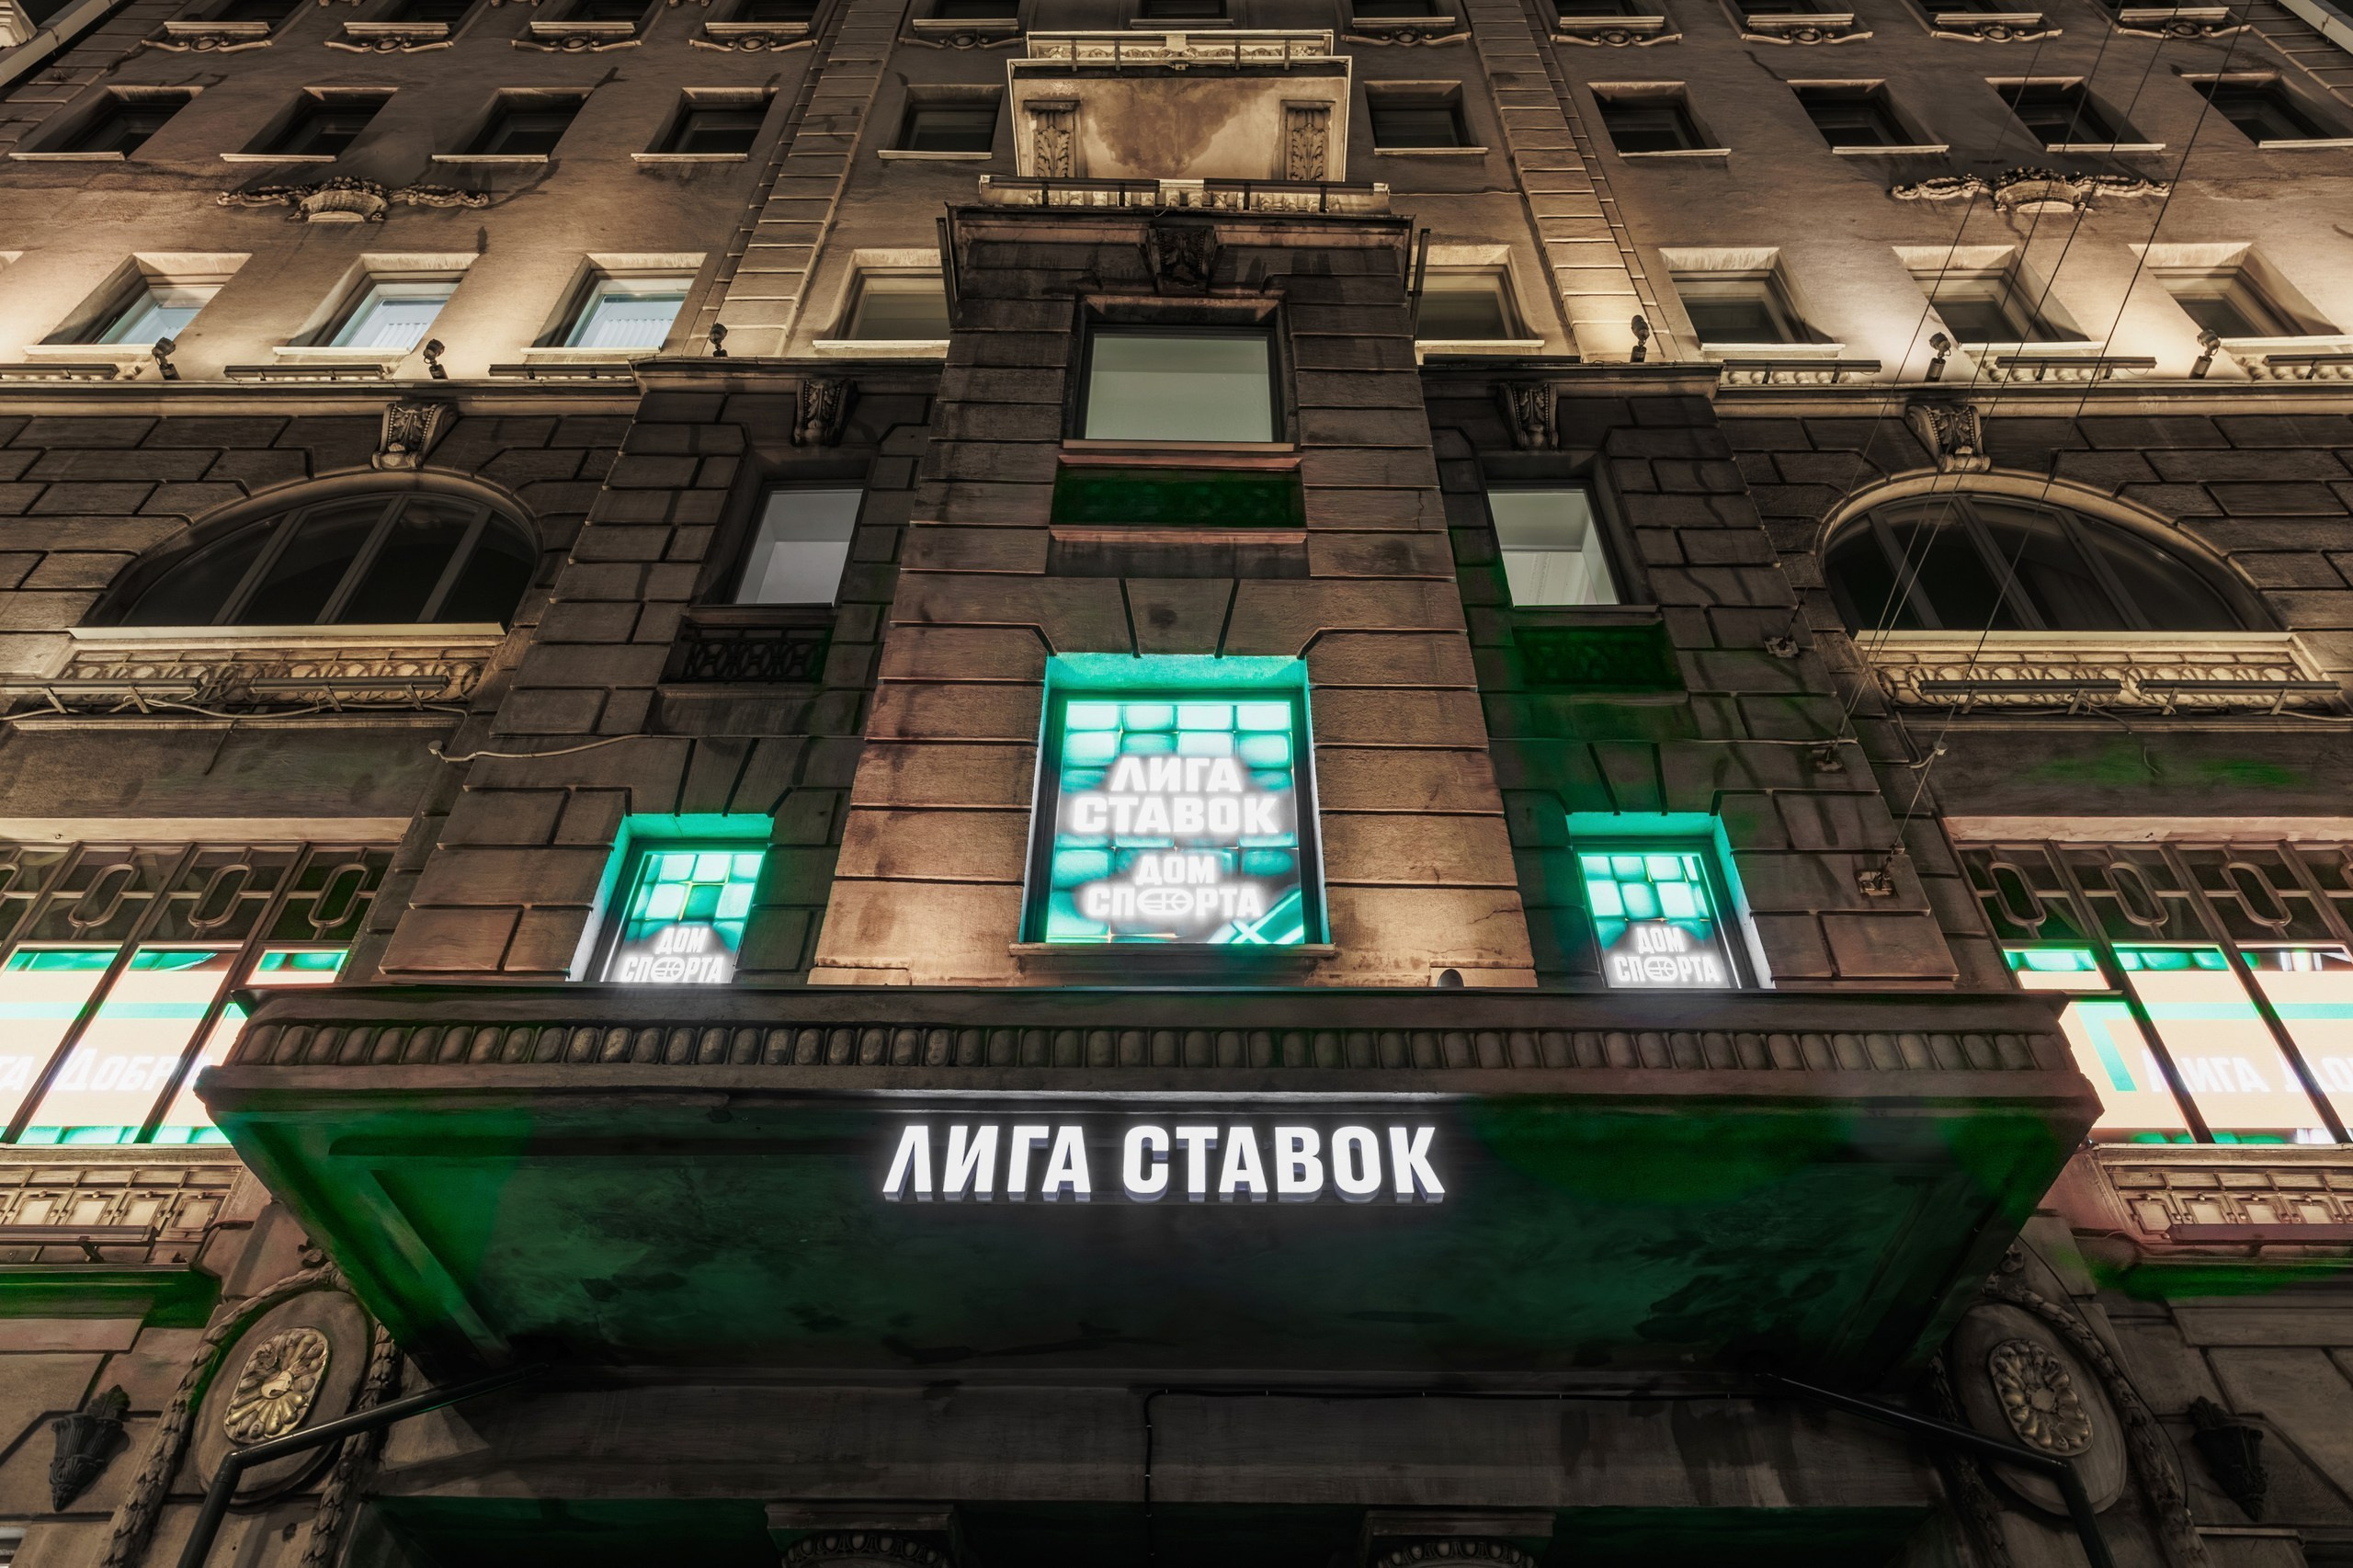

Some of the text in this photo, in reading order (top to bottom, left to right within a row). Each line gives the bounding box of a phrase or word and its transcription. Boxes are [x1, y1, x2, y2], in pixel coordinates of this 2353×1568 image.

[1111, 756, 1243, 792] ЛИГА
[1073, 796, 1280, 834] СТАВОК
[1135, 856, 1216, 885] ДОМ
[654, 927, 709, 954] ДОМ
[1636, 927, 1685, 954] ДОМ
[882, 1125, 1446, 1203] ЛИГА СТАВОК
